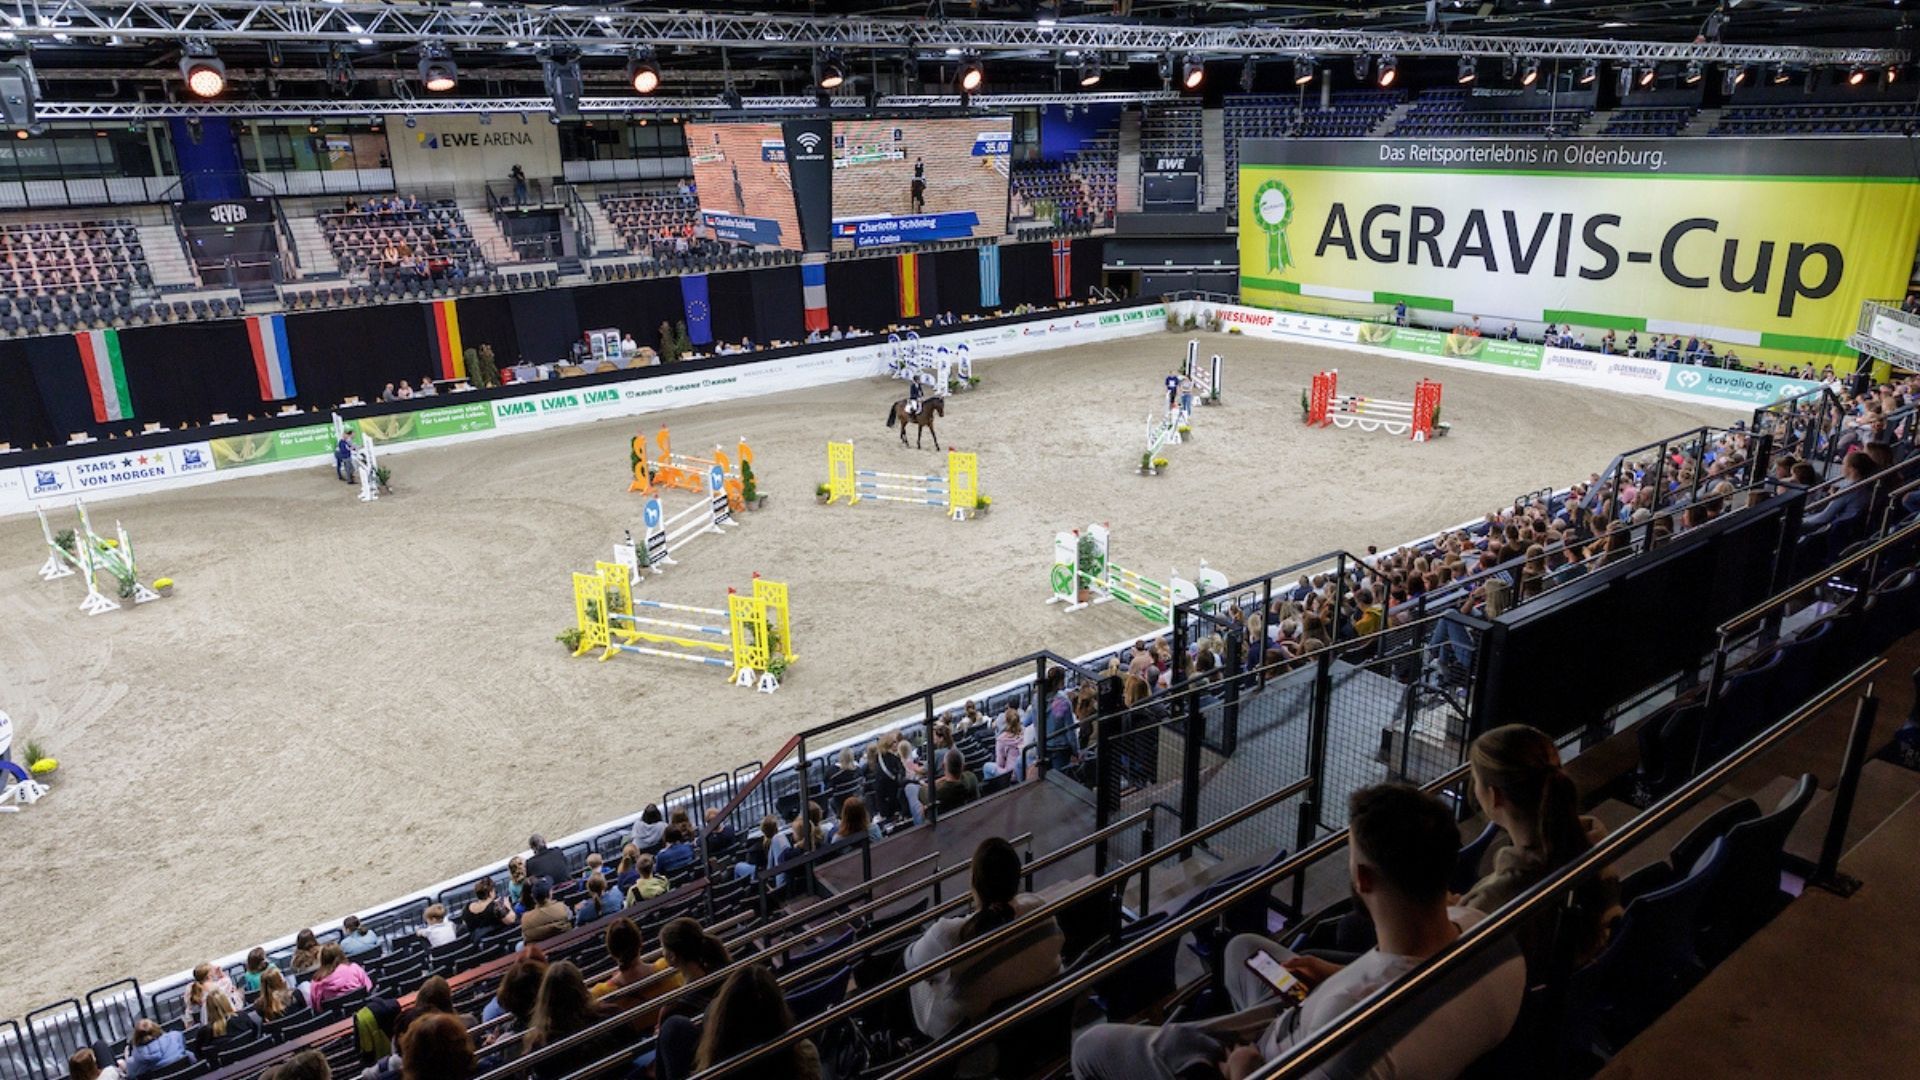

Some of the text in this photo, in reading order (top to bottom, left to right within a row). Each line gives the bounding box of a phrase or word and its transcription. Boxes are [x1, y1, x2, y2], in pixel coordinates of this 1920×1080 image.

[441, 132, 533, 147] EWE ARENA
[1157, 158, 1186, 170] EWE
[1379, 144, 1667, 170] Das Reitsporterlebnis in Oldenburg.
[210, 204, 247, 223] JEVER
[858, 218, 937, 233] Charlotte Schöning
[1315, 201, 1845, 318] AGRAVIS-Cup
[1215, 309, 1274, 326] WIESENHOF
[1707, 373, 1773, 392] kavalio.de
[541, 396, 567, 410] LVM
[583, 390, 608, 404] LVM
[497, 402, 524, 417] LVM
[279, 426, 329, 439] Gemeinsam
[76, 460, 116, 475] STARS
[80, 466, 165, 487] VON MORGEN
